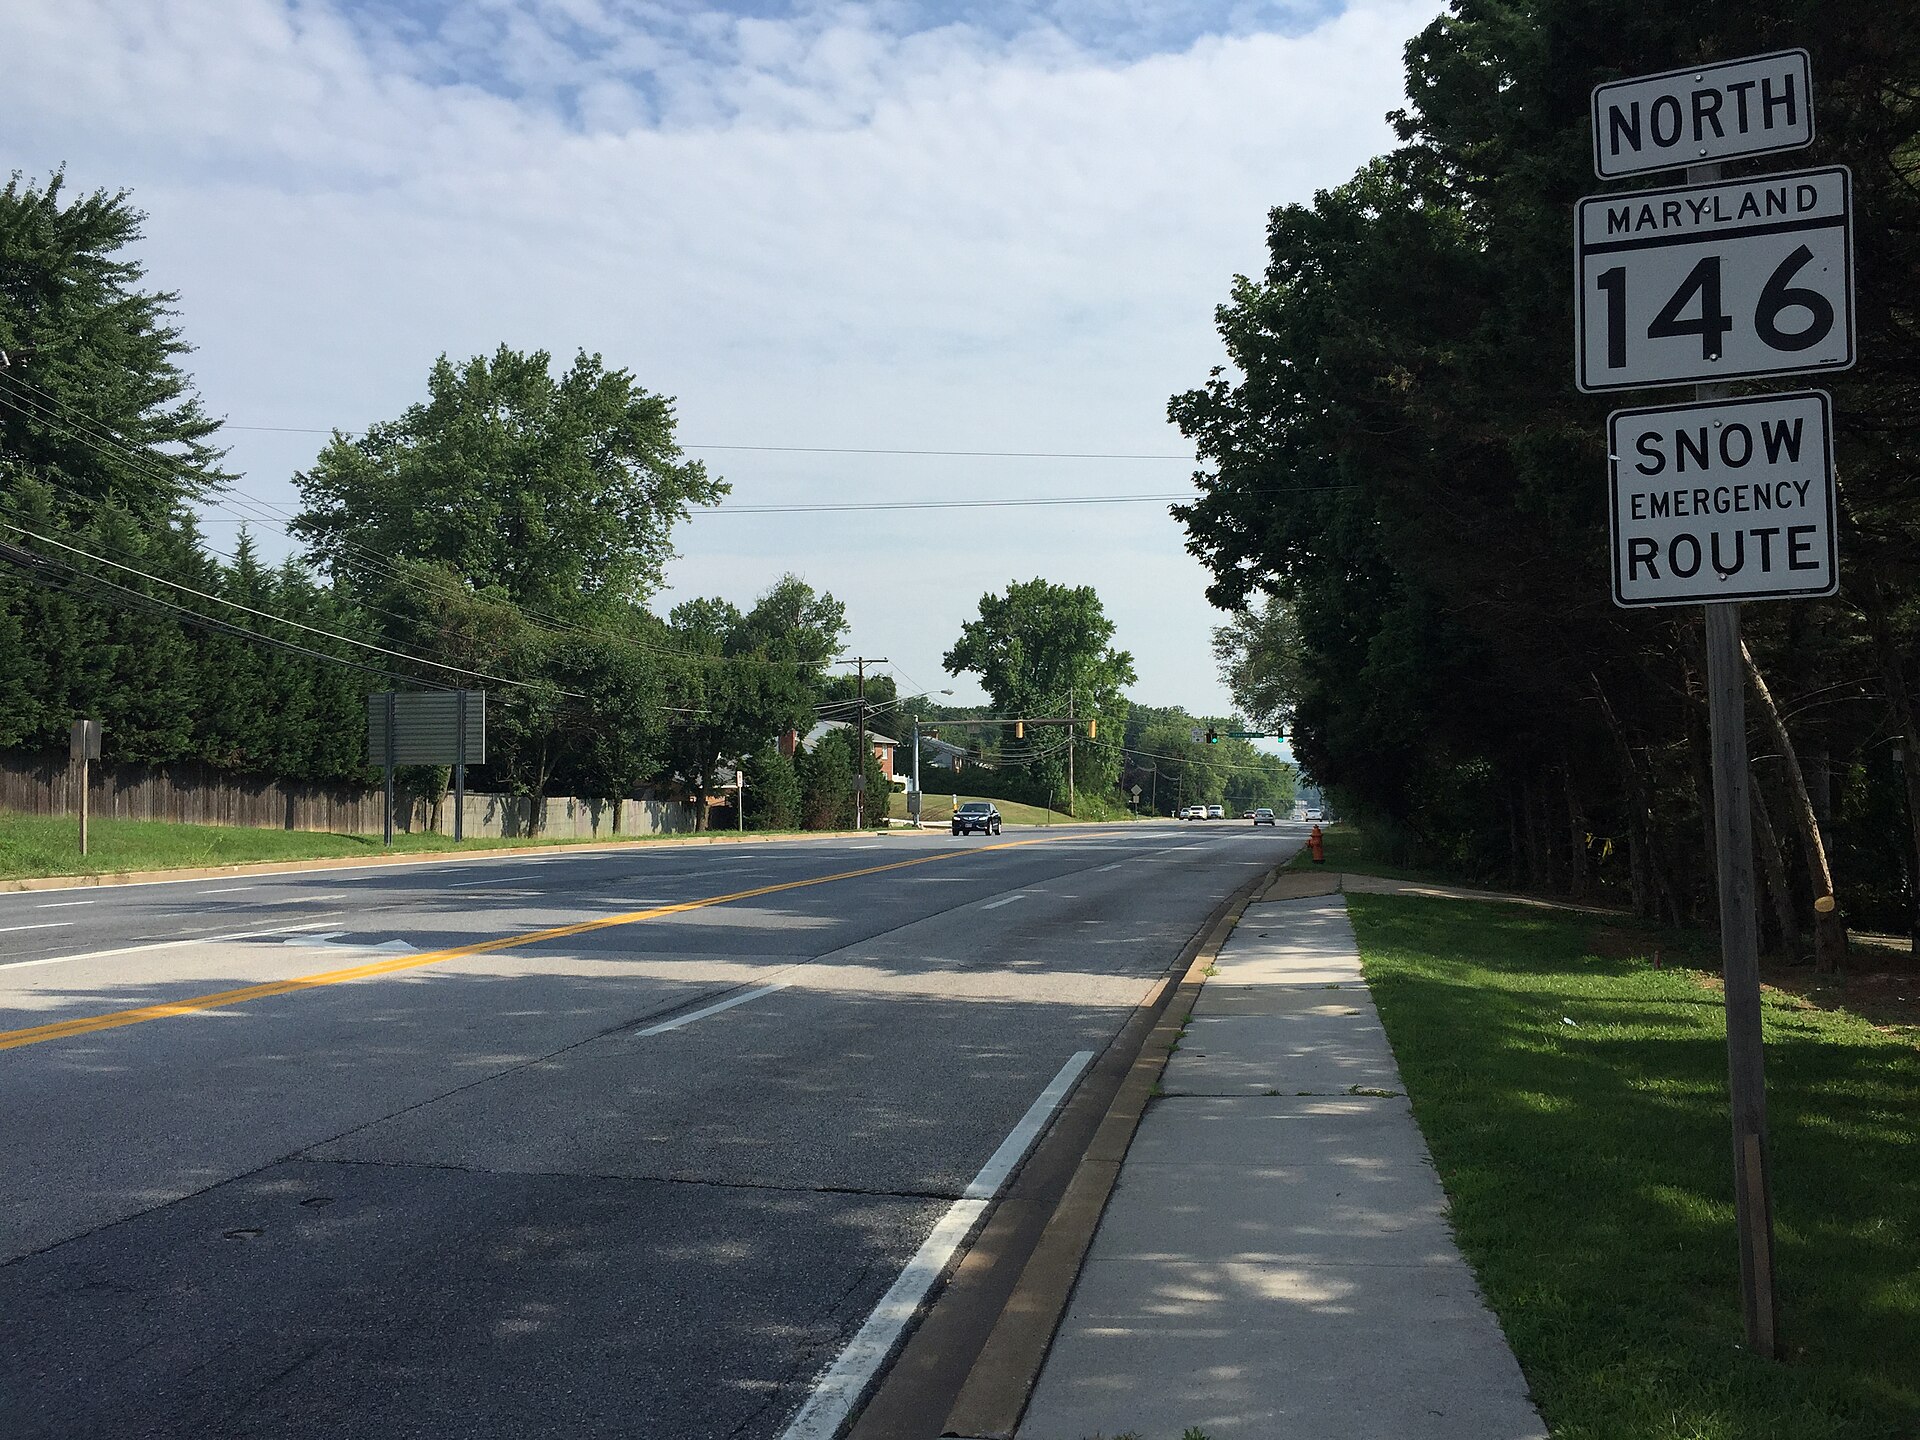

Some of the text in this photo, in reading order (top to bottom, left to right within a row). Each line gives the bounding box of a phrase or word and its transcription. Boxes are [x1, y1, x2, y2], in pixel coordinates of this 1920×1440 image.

[1608, 73, 1798, 156] NORTH
[1607, 184, 1819, 235] MARYLAND
[1597, 243, 1835, 369] 146
[1634, 417, 1804, 476] SNOW
[1631, 479, 1811, 520] EMERGENCY
[1627, 524, 1820, 581] ROUTE
